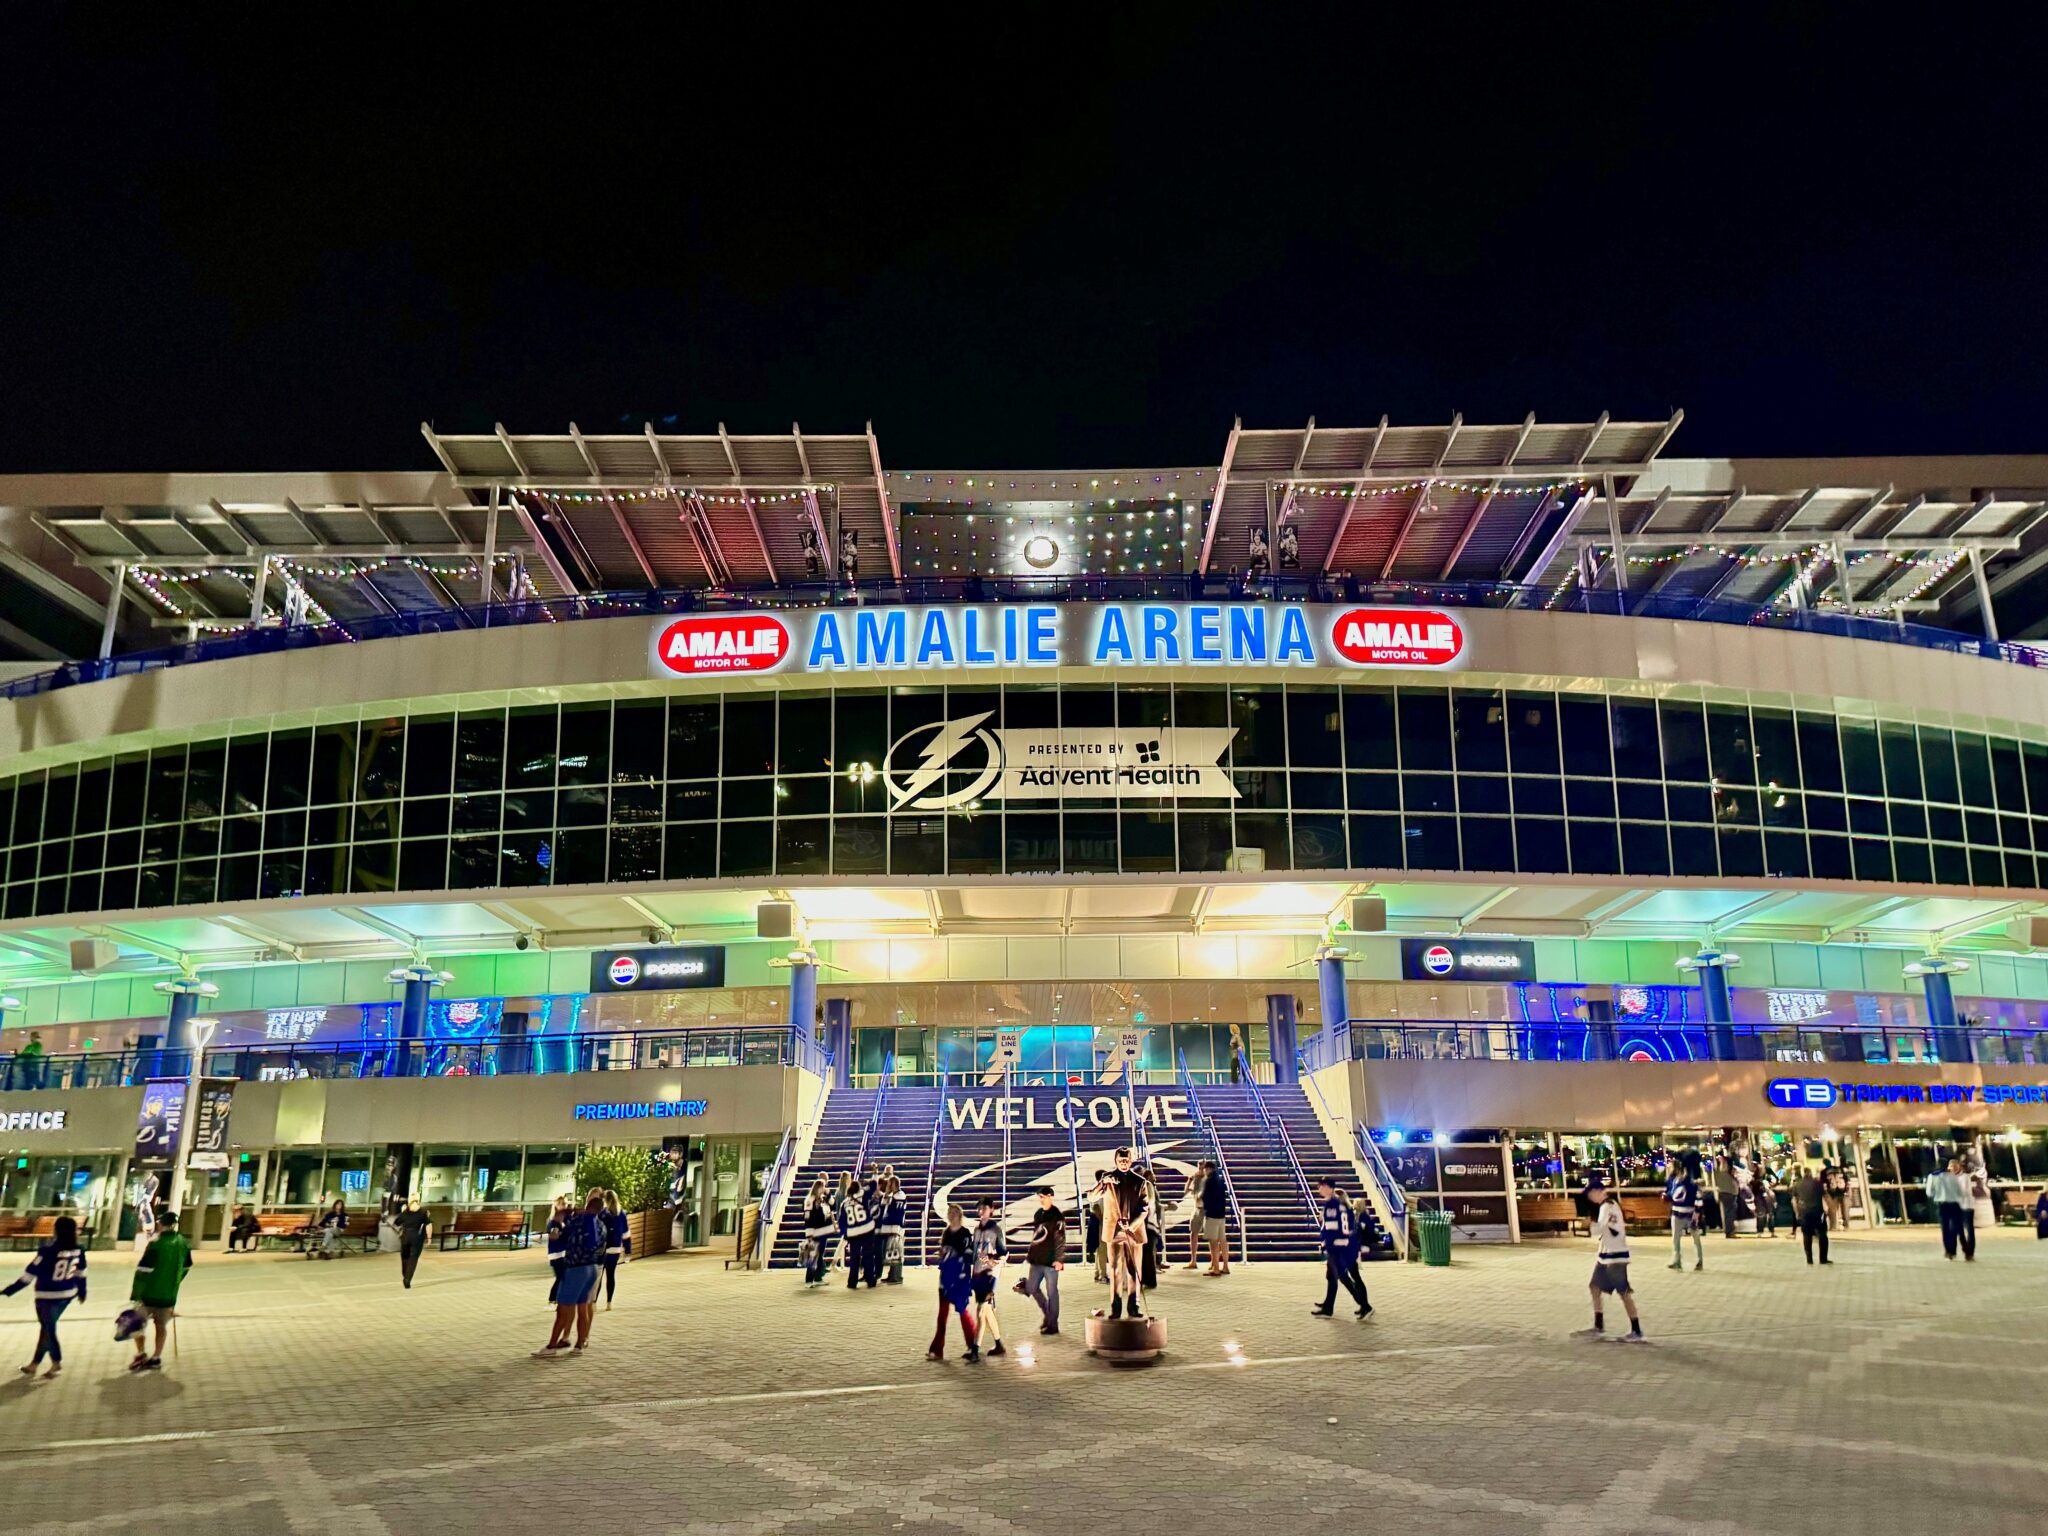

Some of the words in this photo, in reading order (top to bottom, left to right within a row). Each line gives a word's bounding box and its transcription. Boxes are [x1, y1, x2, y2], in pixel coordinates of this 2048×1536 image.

[667, 628, 780, 658] AMALIE
[806, 607, 1058, 668] AMALIE
[1094, 606, 1316, 663] ARENA
[1344, 622, 1455, 653] AMALIE
[694, 659, 730, 668] MOTOR
[733, 658, 751, 667] OIL
[1371, 650, 1408, 660] MOTOR
[1411, 651, 1428, 660] OIL
[1029, 744, 1102, 755] PRESENTED
[1109, 744, 1124, 754] BY
[1019, 765, 1201, 786] AdventHealth
[645, 962, 704, 976] PORCH
[1461, 954, 1519, 967] PORCH
[1774, 1084, 1831, 1102] TB
[1839, 1083, 1924, 1104] TAMPA
[1929, 1084, 1976, 1104] BAY
[575, 1103, 650, 1120] PREMIUM
[654, 1100, 707, 1118] ENTRY
[947, 1095, 1195, 1130] WELCOME
[846, 1204, 866, 1225] 86
